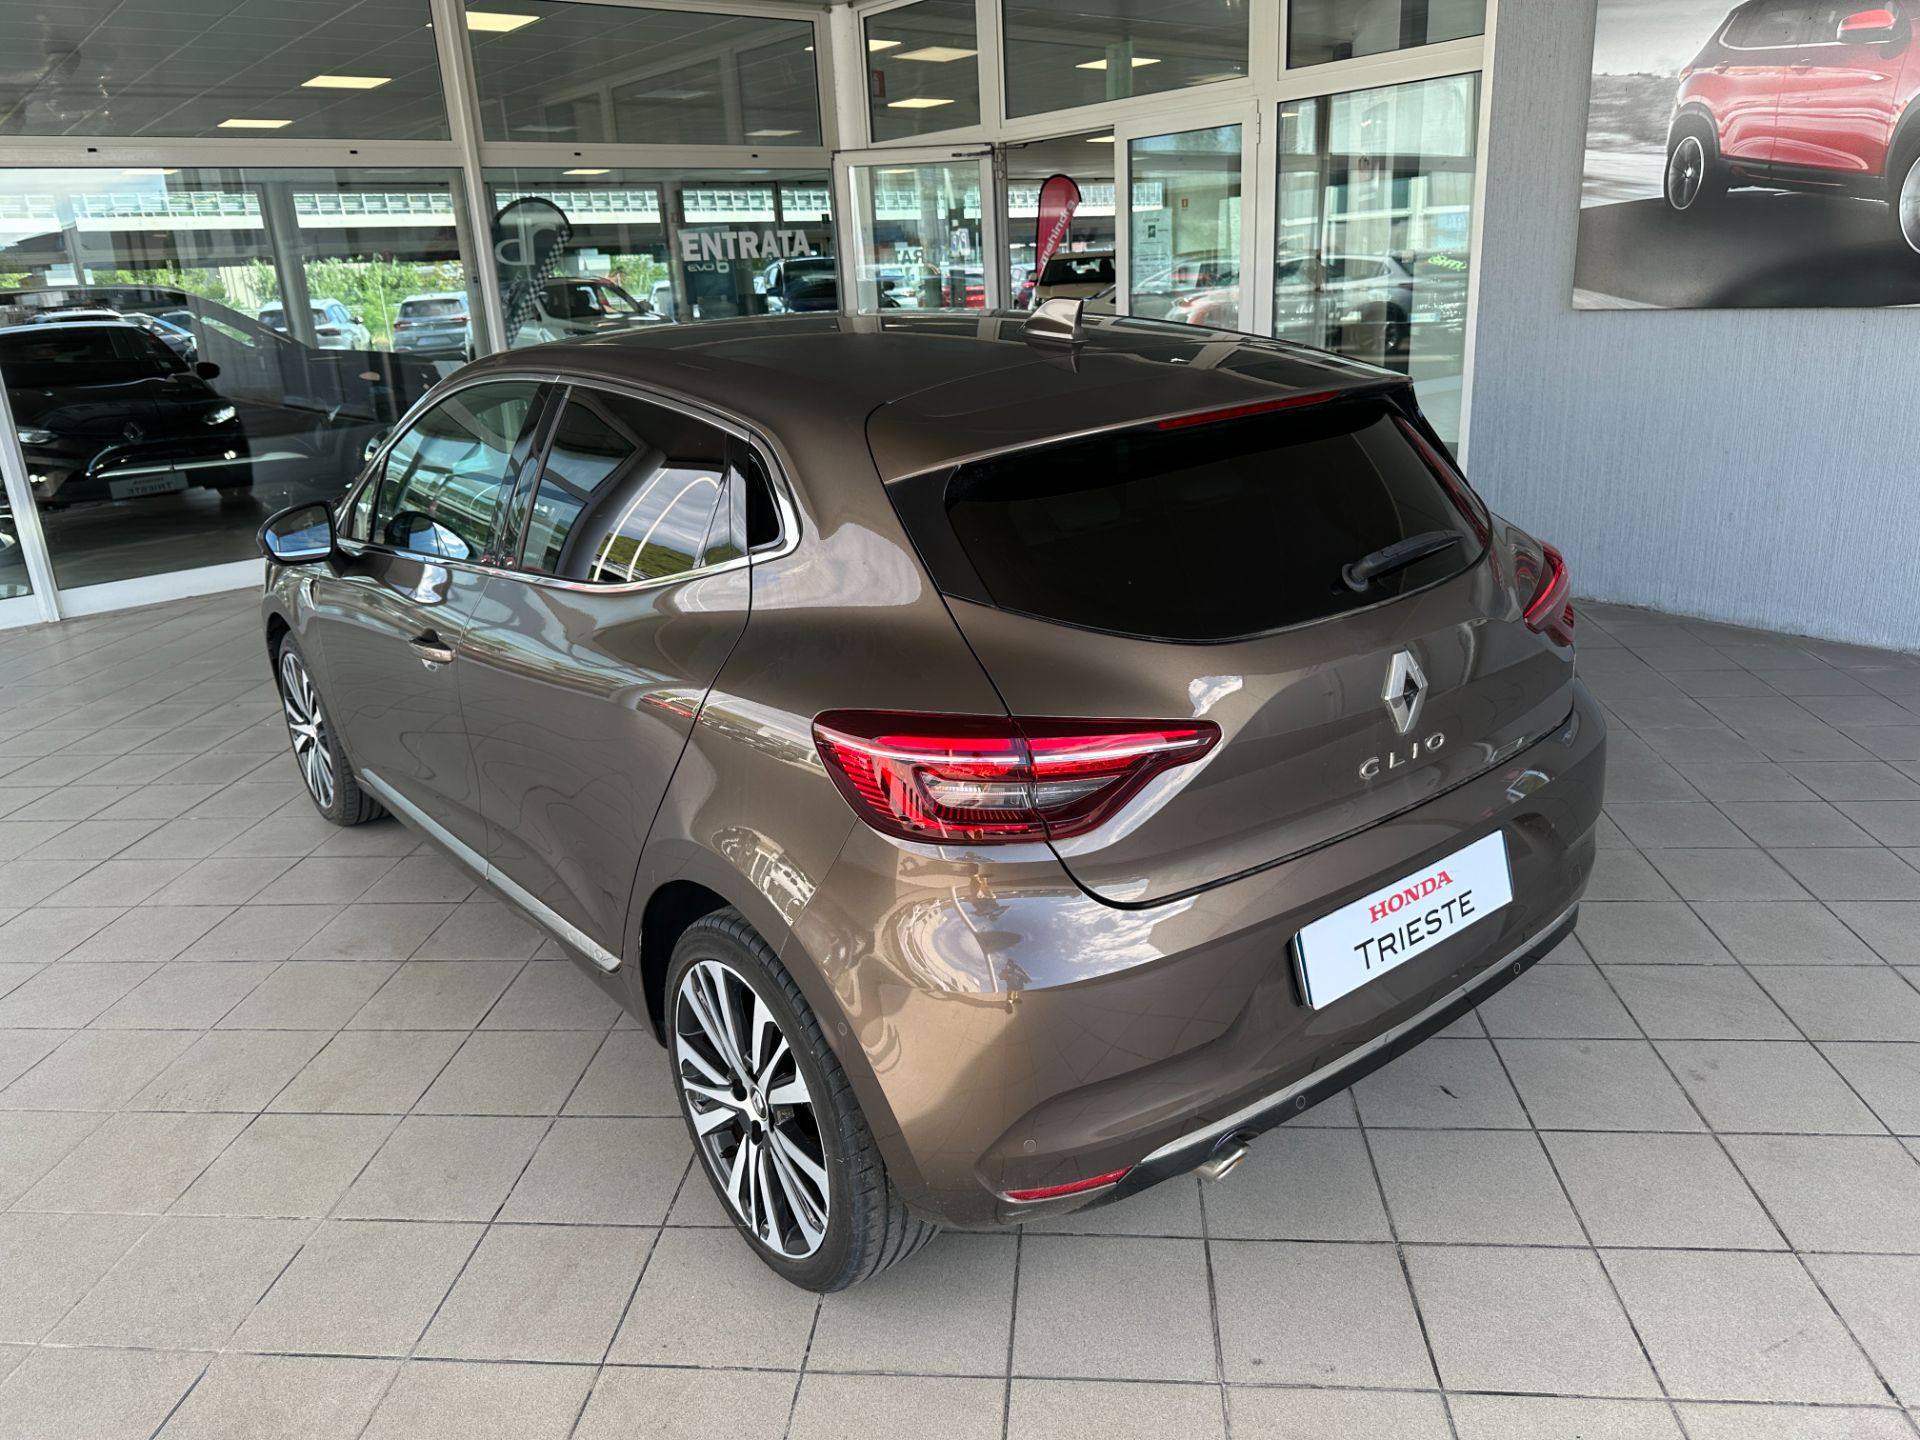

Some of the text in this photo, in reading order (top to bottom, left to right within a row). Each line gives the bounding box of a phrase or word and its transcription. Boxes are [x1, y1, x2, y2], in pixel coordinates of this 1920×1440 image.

[681, 229, 811, 261] ENTRATA
[1359, 732, 1445, 780] CLIO
[1368, 870, 1453, 923] HONDA
[1353, 889, 1476, 970] TRIESTE
